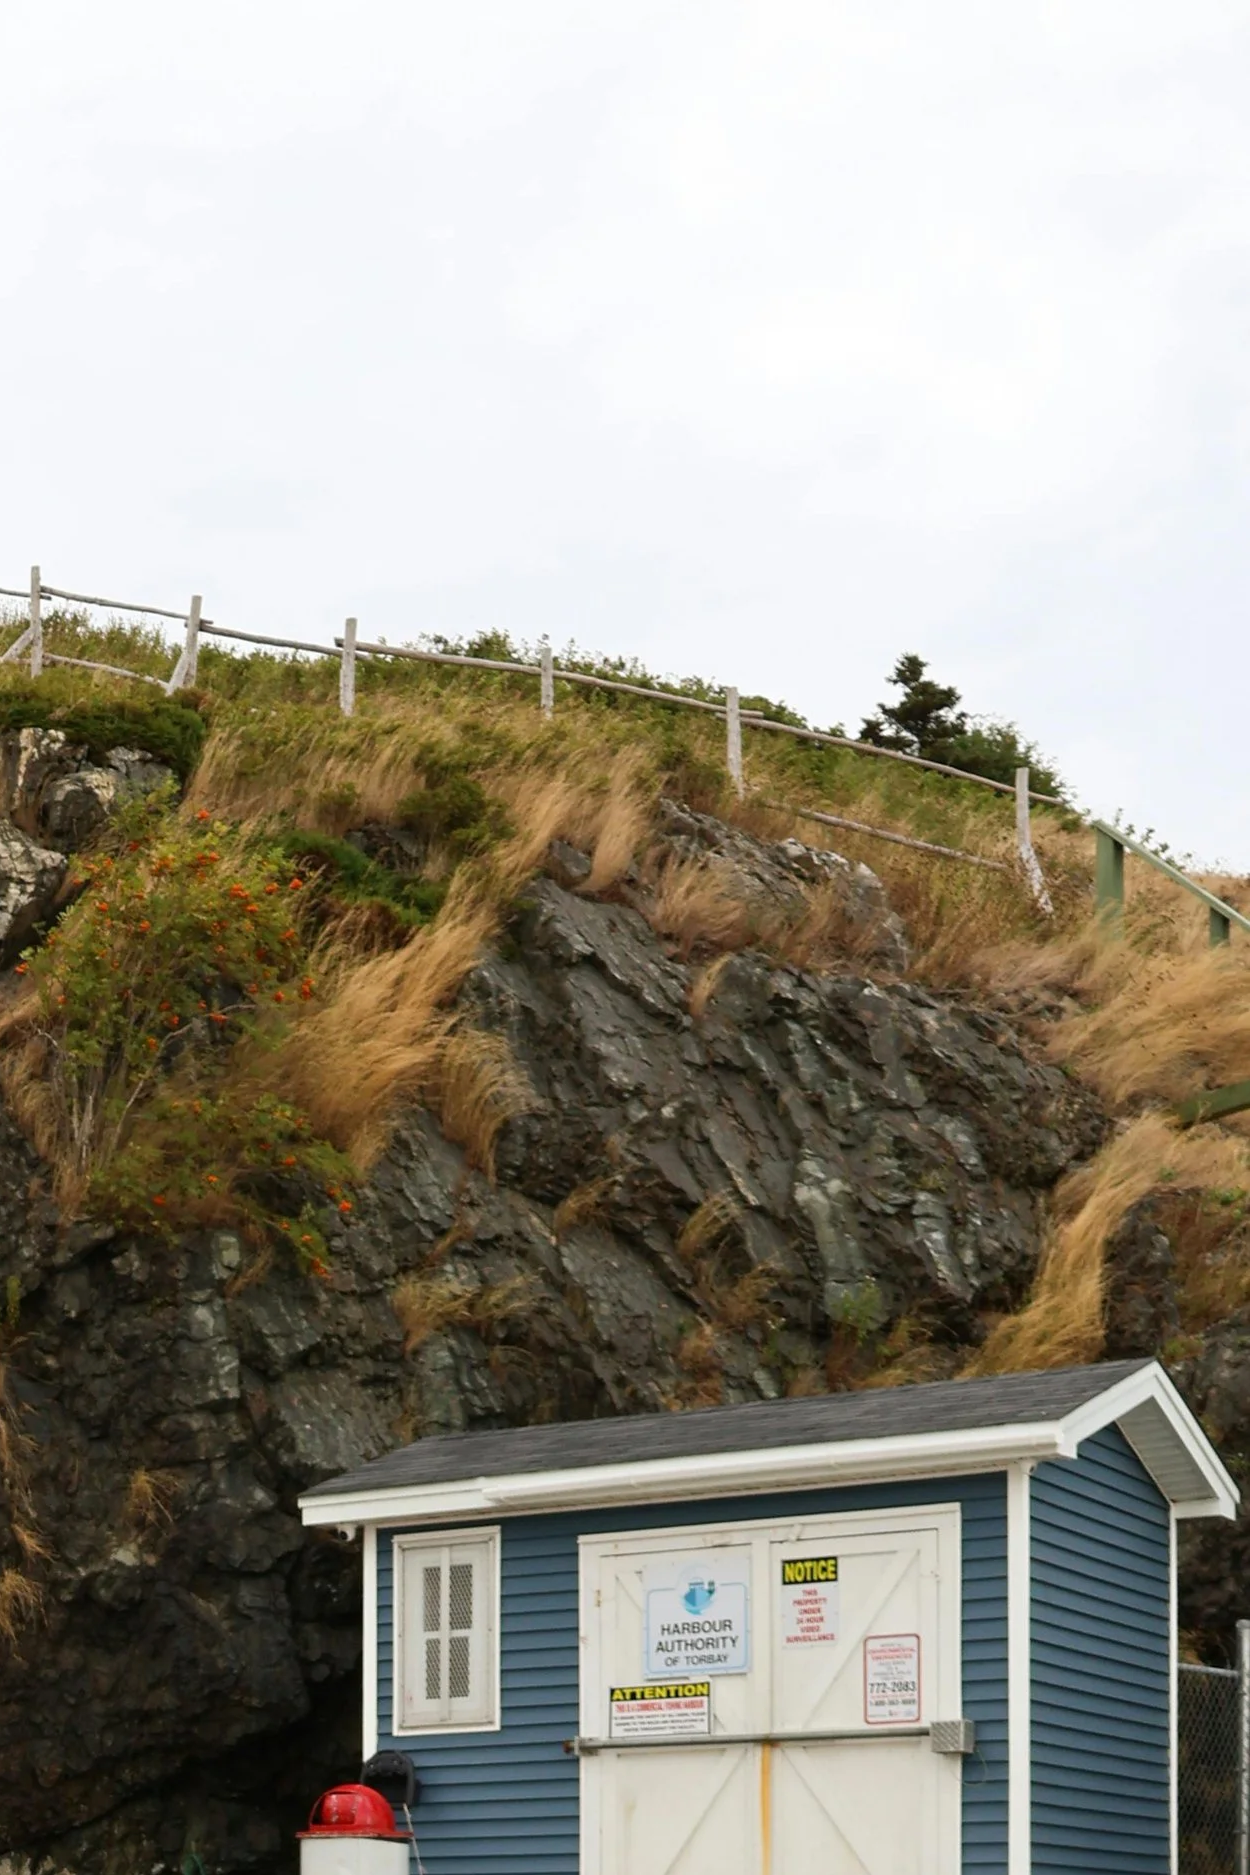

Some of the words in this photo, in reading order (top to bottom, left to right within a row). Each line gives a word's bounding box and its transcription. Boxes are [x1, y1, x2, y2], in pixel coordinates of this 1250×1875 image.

[784, 1559, 836, 1583] NOTICE
[660, 1618, 733, 1636] HARBOUR
[655, 1636, 739, 1653] AUTHORITY
[664, 1656, 679, 1667] OF
[684, 1654, 729, 1666] TORBAY
[612, 1683, 709, 1700] ATTENTION
[869, 1681, 916, 1693] 772-2083
